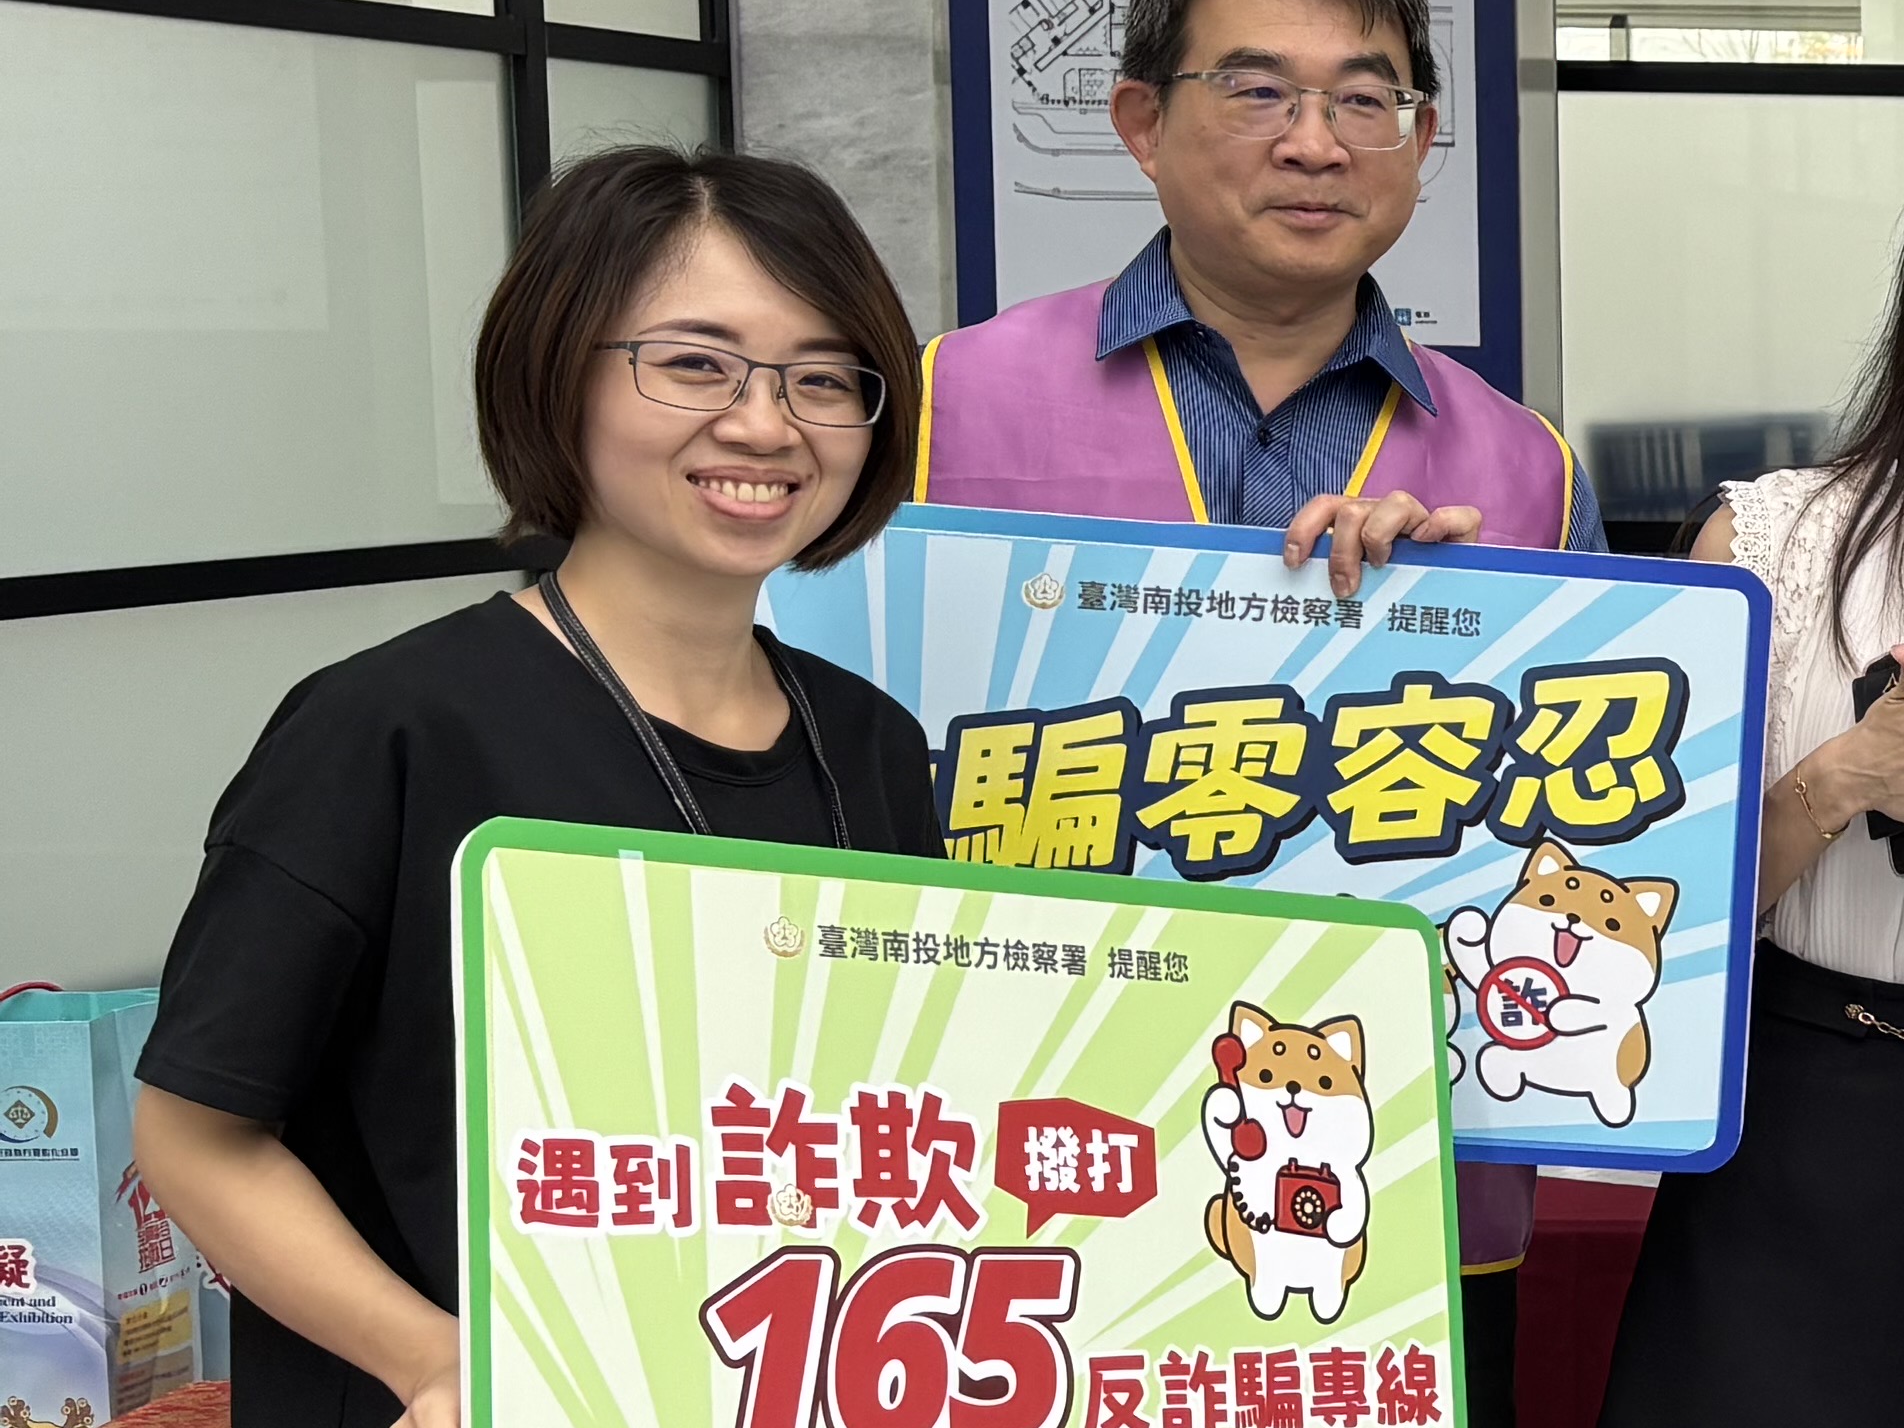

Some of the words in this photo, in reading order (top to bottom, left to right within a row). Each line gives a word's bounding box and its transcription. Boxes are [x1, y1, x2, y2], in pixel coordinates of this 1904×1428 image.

[1077, 579, 1365, 630] 臺灣南投地方檢察署
[1387, 602, 1482, 639] 提醒您
[932, 668, 1672, 869] 騙零容忍
[817, 923, 1088, 979] 臺灣南投地方檢察署
[1107, 948, 1191, 985] 提醒您
[517, 1138, 694, 1229] 遇到
[711, 1082, 981, 1232] 詐欺
[1023, 1124, 1140, 1195] 撥打
